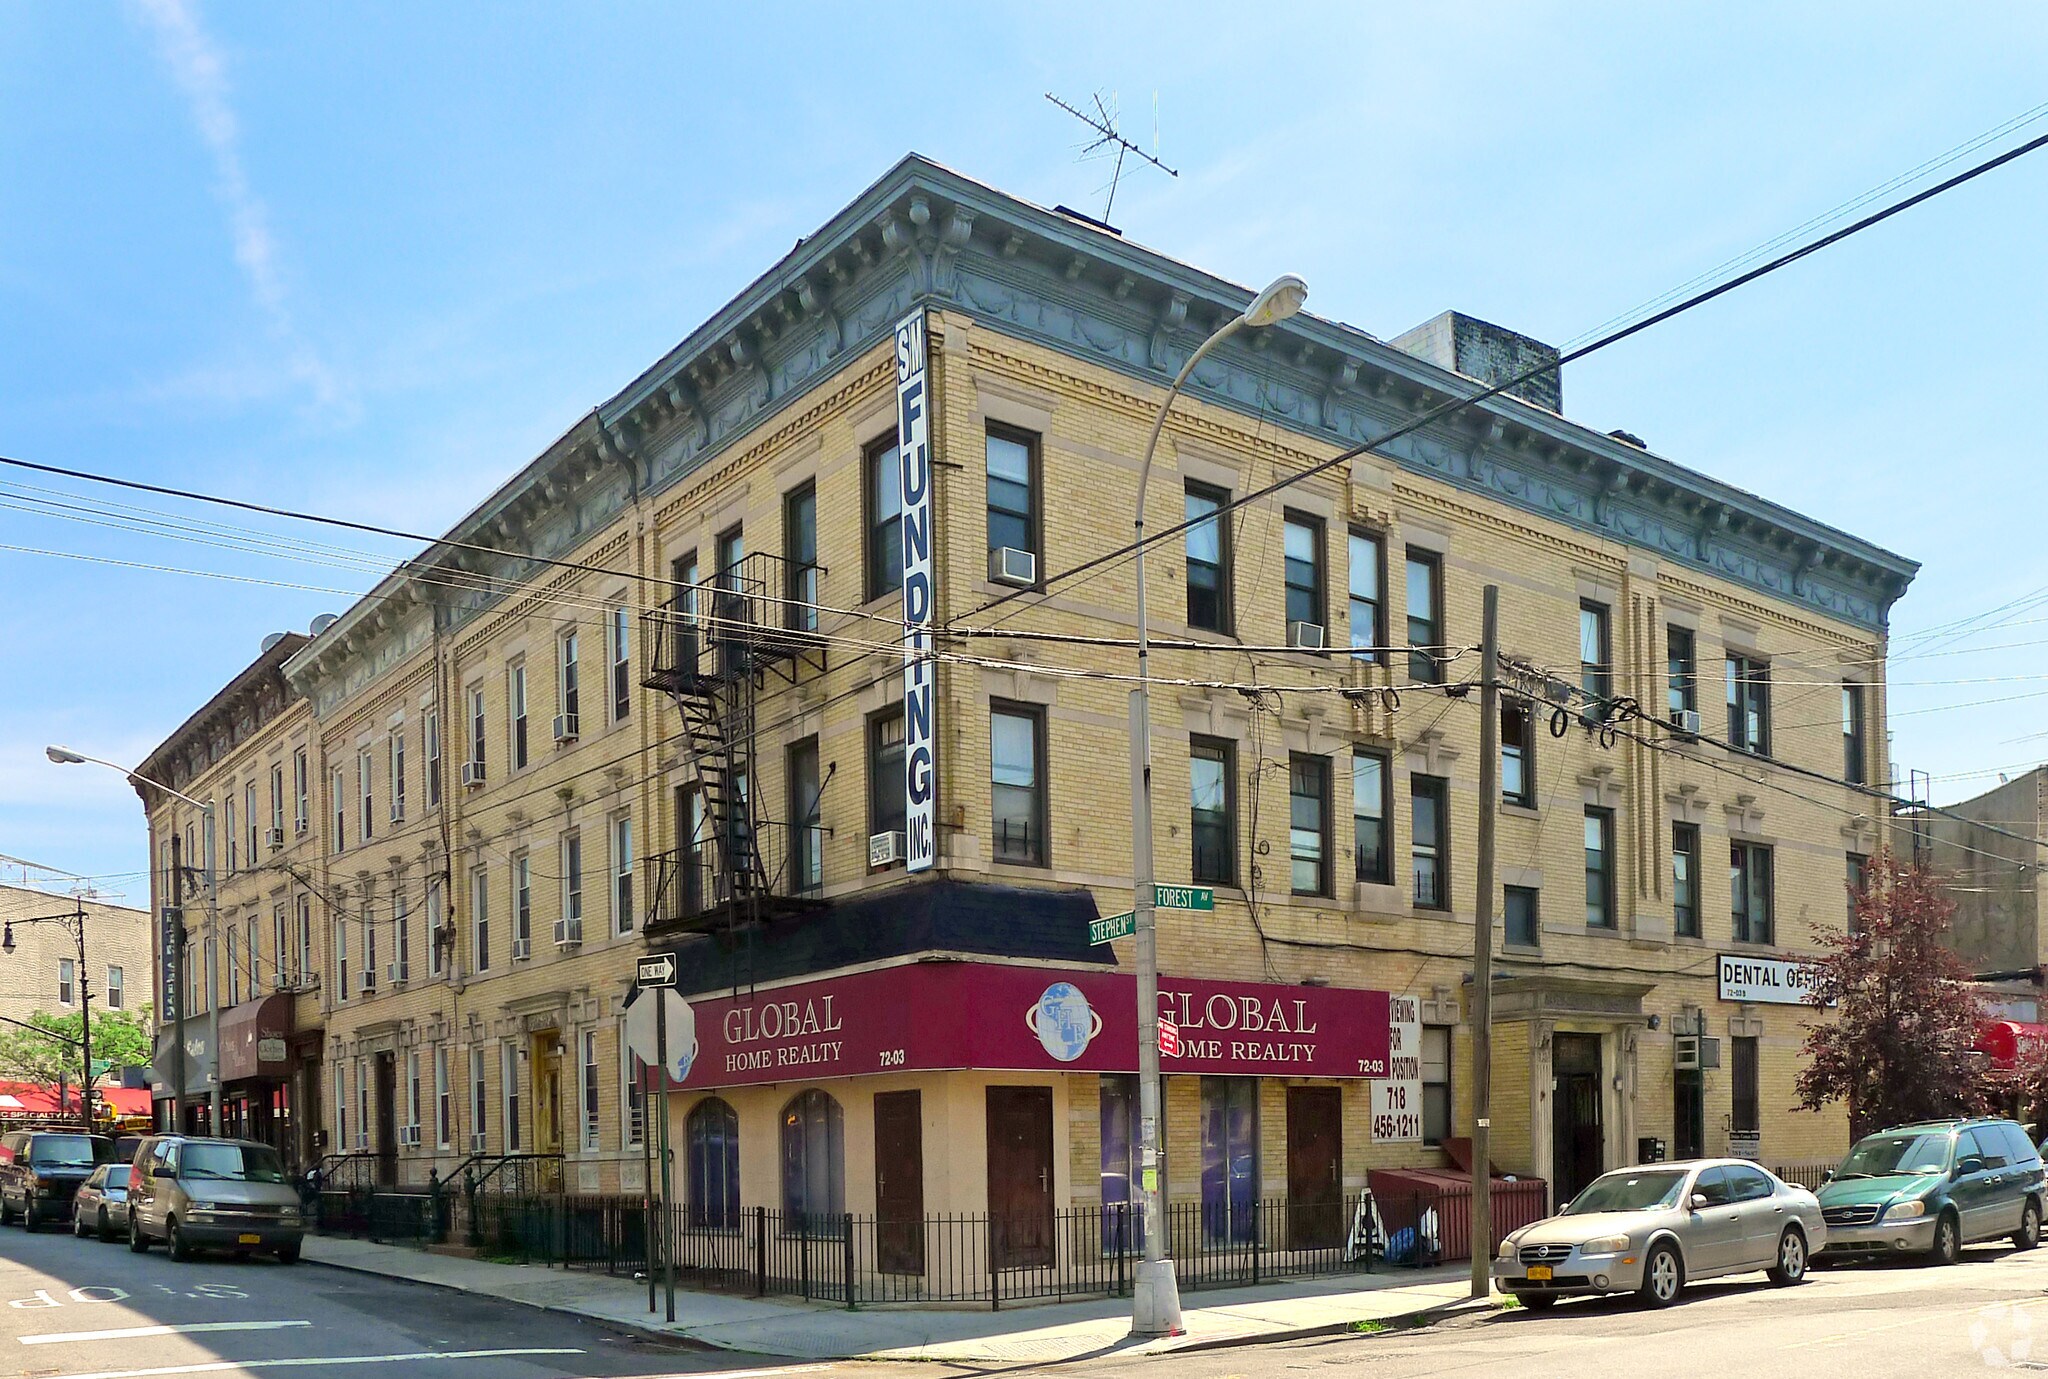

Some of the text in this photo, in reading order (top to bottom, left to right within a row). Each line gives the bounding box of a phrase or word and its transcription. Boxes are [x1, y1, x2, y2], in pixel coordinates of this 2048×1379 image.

[898, 324, 924, 385] SM
[900, 394, 931, 805] FUNDING
[1157, 887, 1209, 908] FOREST AV
[1091, 914, 1133, 942] STEPHEN ST
[641, 964, 666, 978] ONE WAY
[1723, 963, 1780, 987] DENTAL
[723, 994, 843, 1044] GLOBAL
[725, 1041, 843, 1072] HOME REALTY
[879, 1049, 905, 1067] 72-03
[1231, 1041, 1317, 1063] REALTY
[1358, 1059, 1384, 1073] 72-03
[1392, 1056, 1418, 1080] POSITION
[1387, 1086, 1406, 1109] 718
[1374, 1114, 1419, 1138] 456-1211
